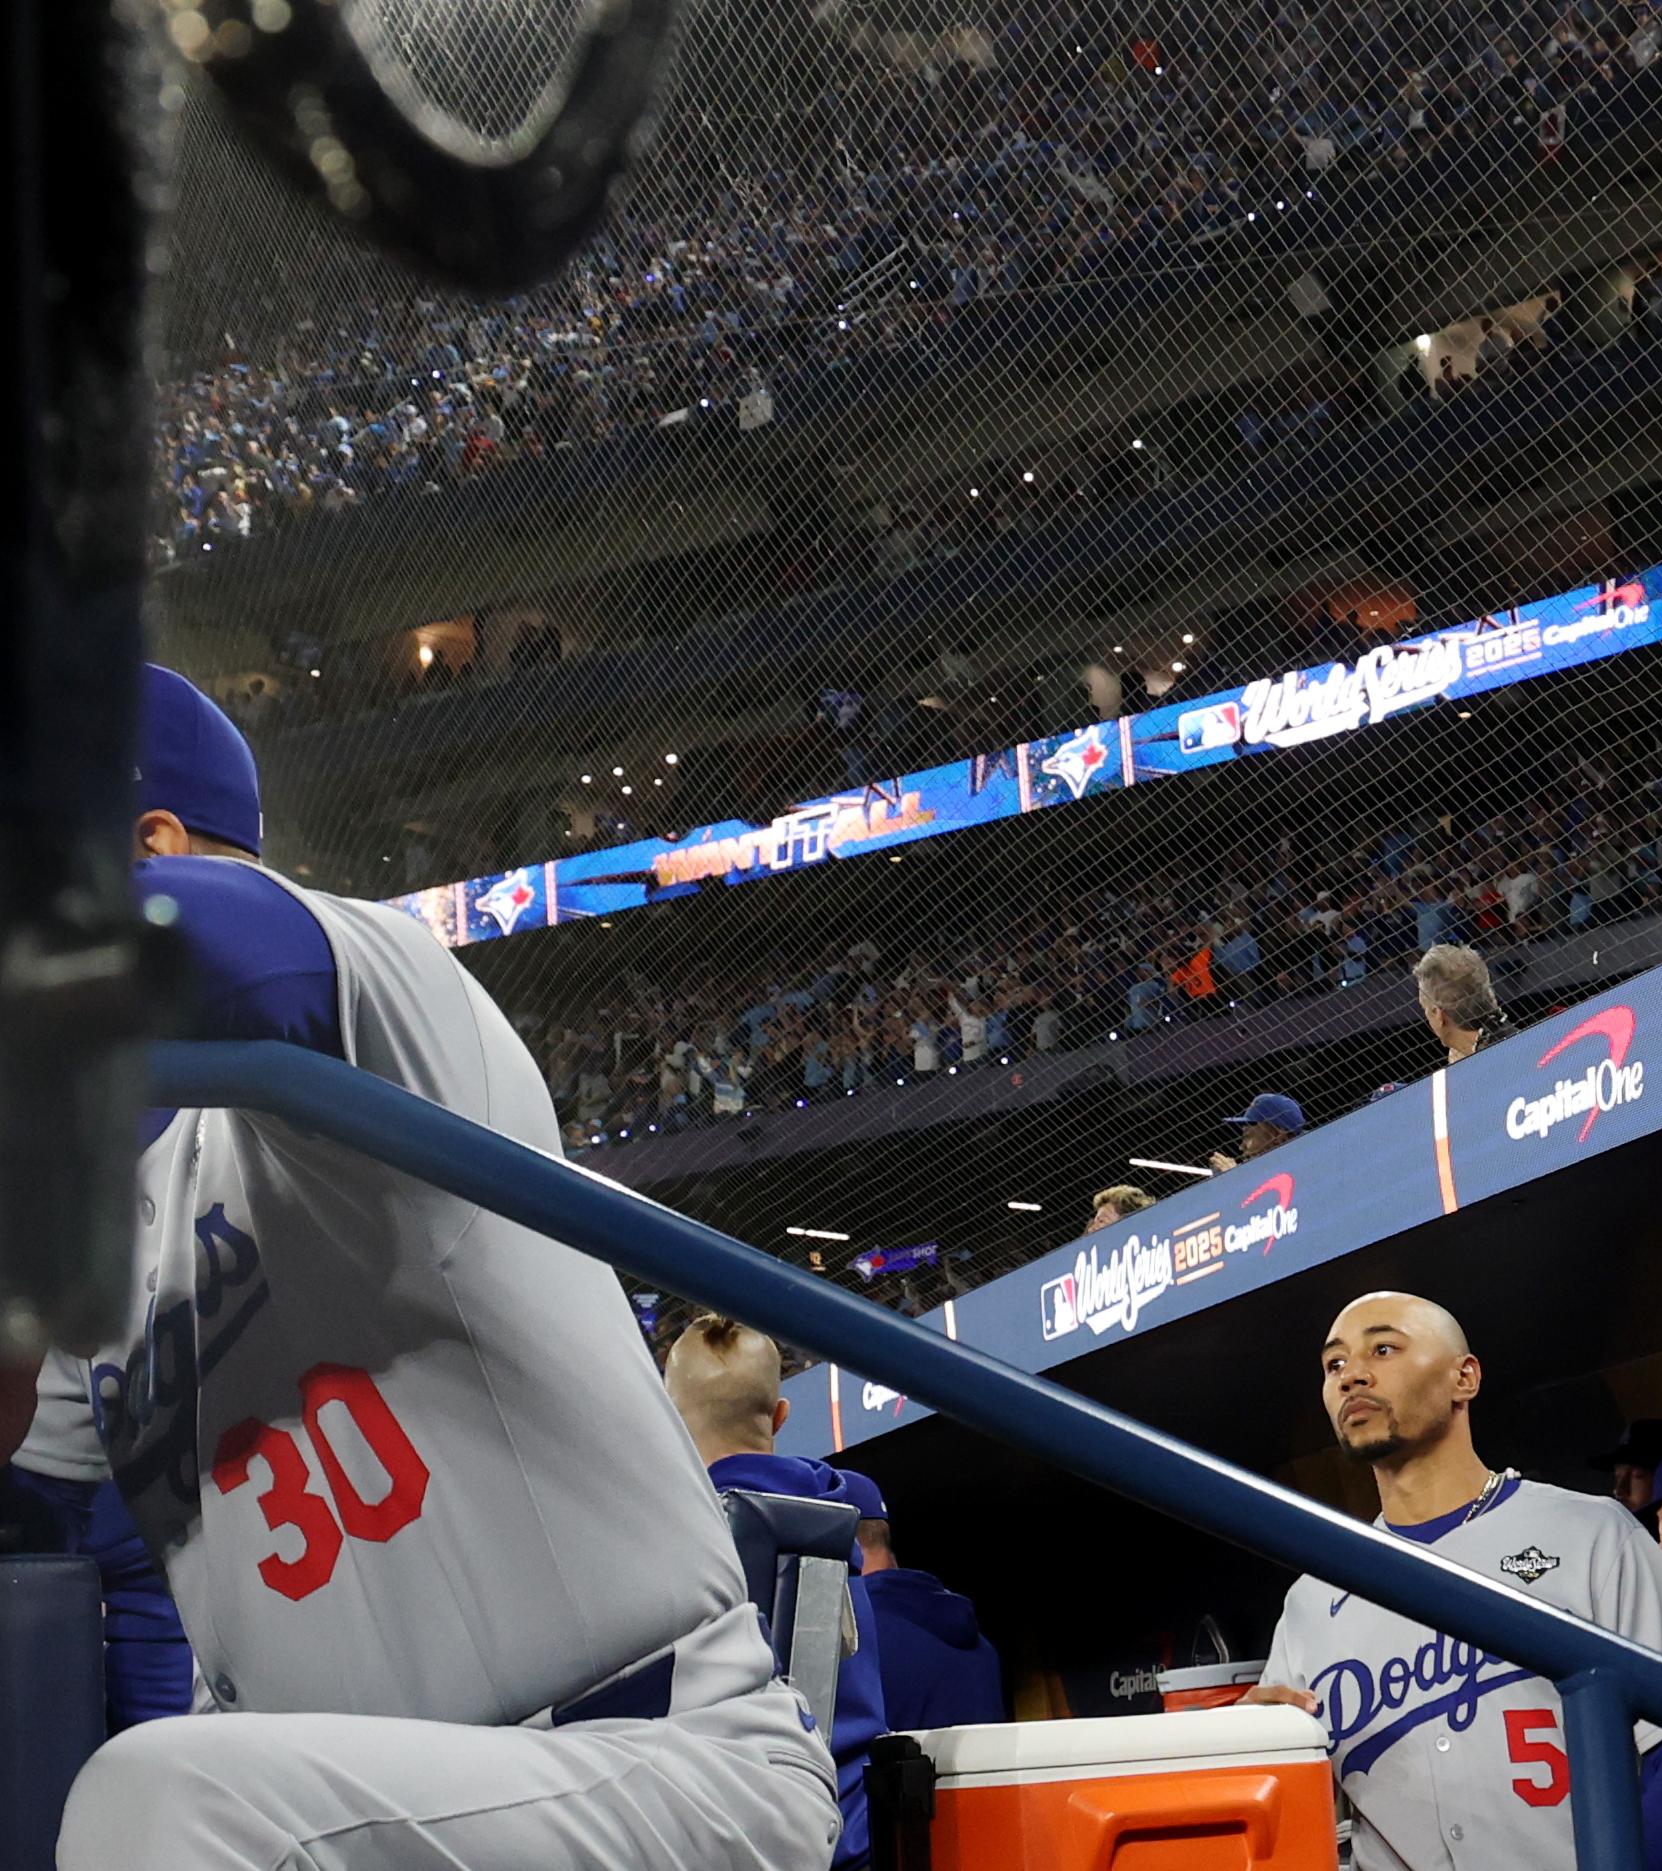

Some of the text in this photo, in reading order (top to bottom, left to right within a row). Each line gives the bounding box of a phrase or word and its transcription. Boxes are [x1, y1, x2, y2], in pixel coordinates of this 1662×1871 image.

[1173, 1225, 1223, 1273] 2025
[211, 1360, 431, 1602] 30
[1308, 1631, 1505, 1756] Dodg
[1502, 1708, 1571, 1808] 5
